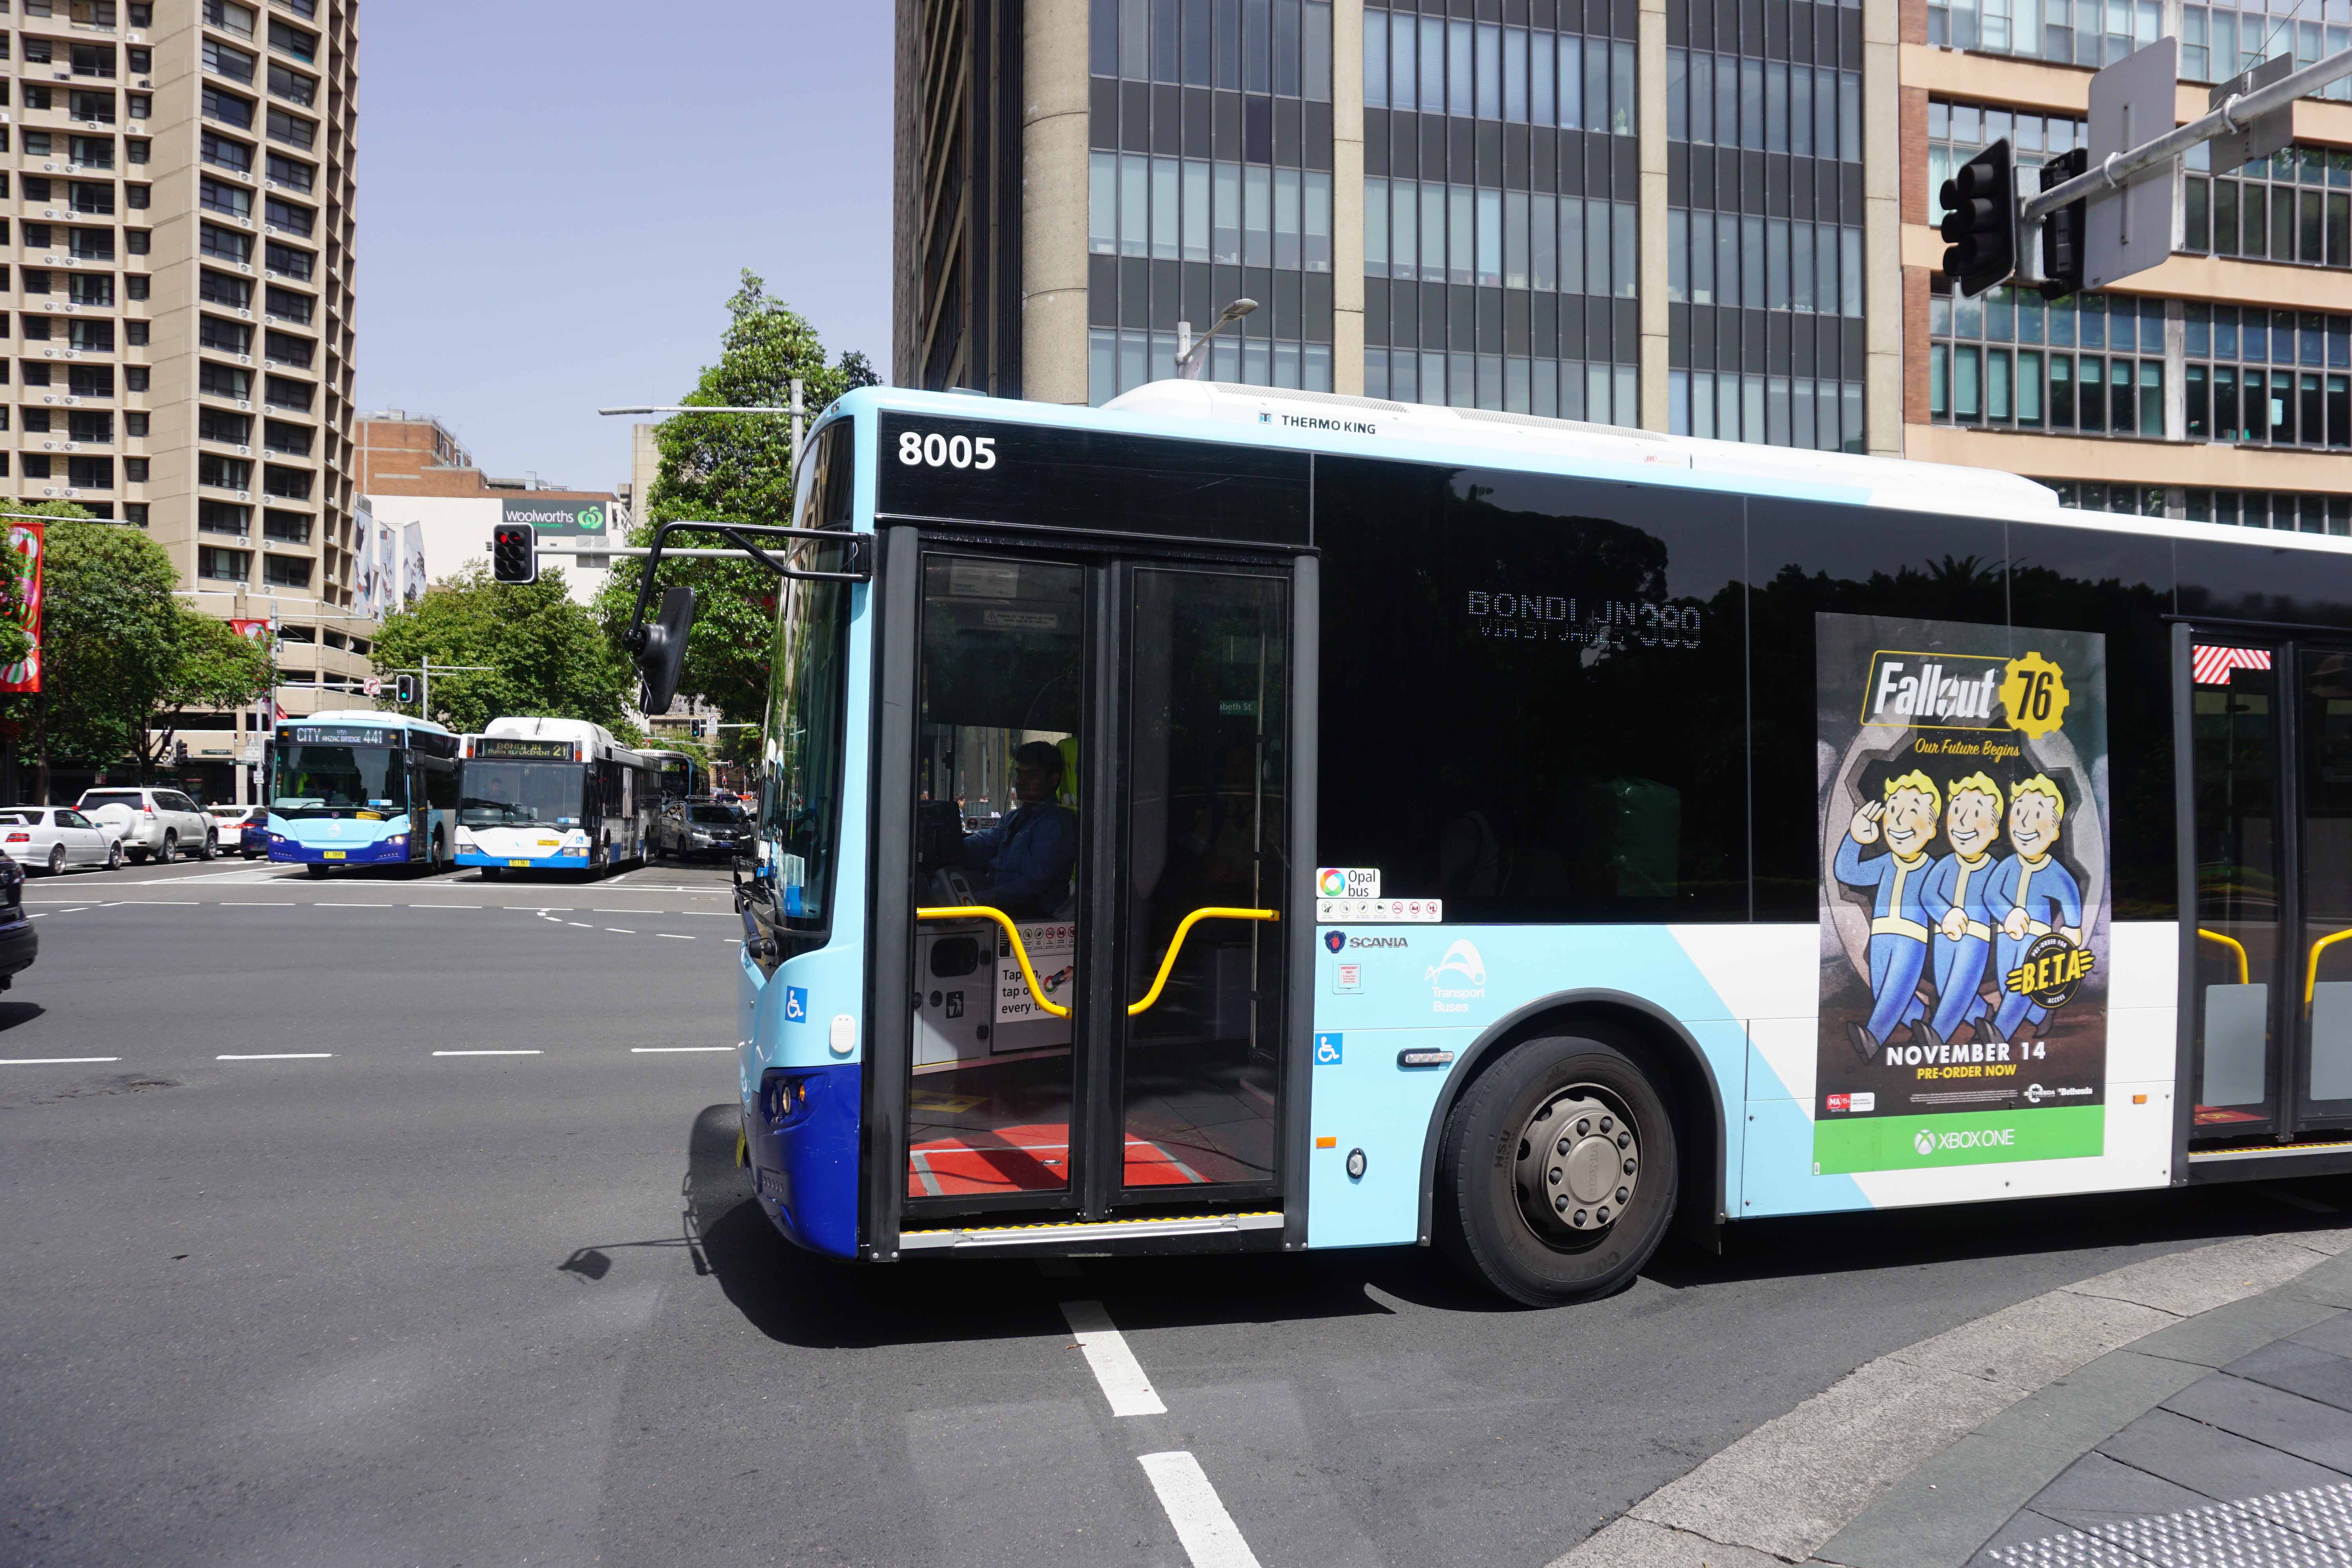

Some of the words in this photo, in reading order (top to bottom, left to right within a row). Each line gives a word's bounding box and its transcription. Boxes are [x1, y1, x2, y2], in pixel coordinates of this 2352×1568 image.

[1281, 415, 1341, 430] THERMO
[1344, 421, 1376, 434] KING
[899, 431, 996, 470] 8005
[506, 509, 574, 522] Woolworths
[1469, 591, 1575, 621] BONDI
[1595, 601, 1635, 625] JN
[1479, 618, 1517, 638] VIA
[1524, 621, 1551, 640] ST
[1874, 662, 1995, 722] Fallout
[2017, 670, 2054, 721] 76
[1220, 702, 1241, 710] abeth
[297, 727, 321, 742] CITY
[363, 730, 383, 744] 441
[553, 745, 566, 756] 21
[1915, 737, 1939, 755] Our
[1942, 739, 1980, 755] Future
[1983, 742, 2020, 763] Begins
[1348, 869, 1376, 888] Opal
[1348, 883, 1369, 897] bus
[1349, 936, 1409, 949] SCANIA
[2032, 938, 2056, 957] PRE-ORDER
[2058, 939, 2067, 949] FOR
[1003, 969, 1022, 982] Tap
[1002, 987, 1019, 999] tap
[1431, 986, 1486, 1000] Transport
[2047, 994, 2065, 1004] ACCESS
[1002, 1004, 1031, 1014] every
[1433, 1001, 1468, 1013] Buses
[1887, 1043, 2010, 1065] NOVEMBER
[2022, 1041, 2046, 1060] 14
[1916, 1065, 1984, 1080] PRE-ORDER
[1985, 1064, 2017, 1077] NOW
[2061, 1087, 2093, 1096] Bethesda
[1938, 1130, 1984, 1149] XBOX
[1984, 1129, 2015, 1147] ONE
